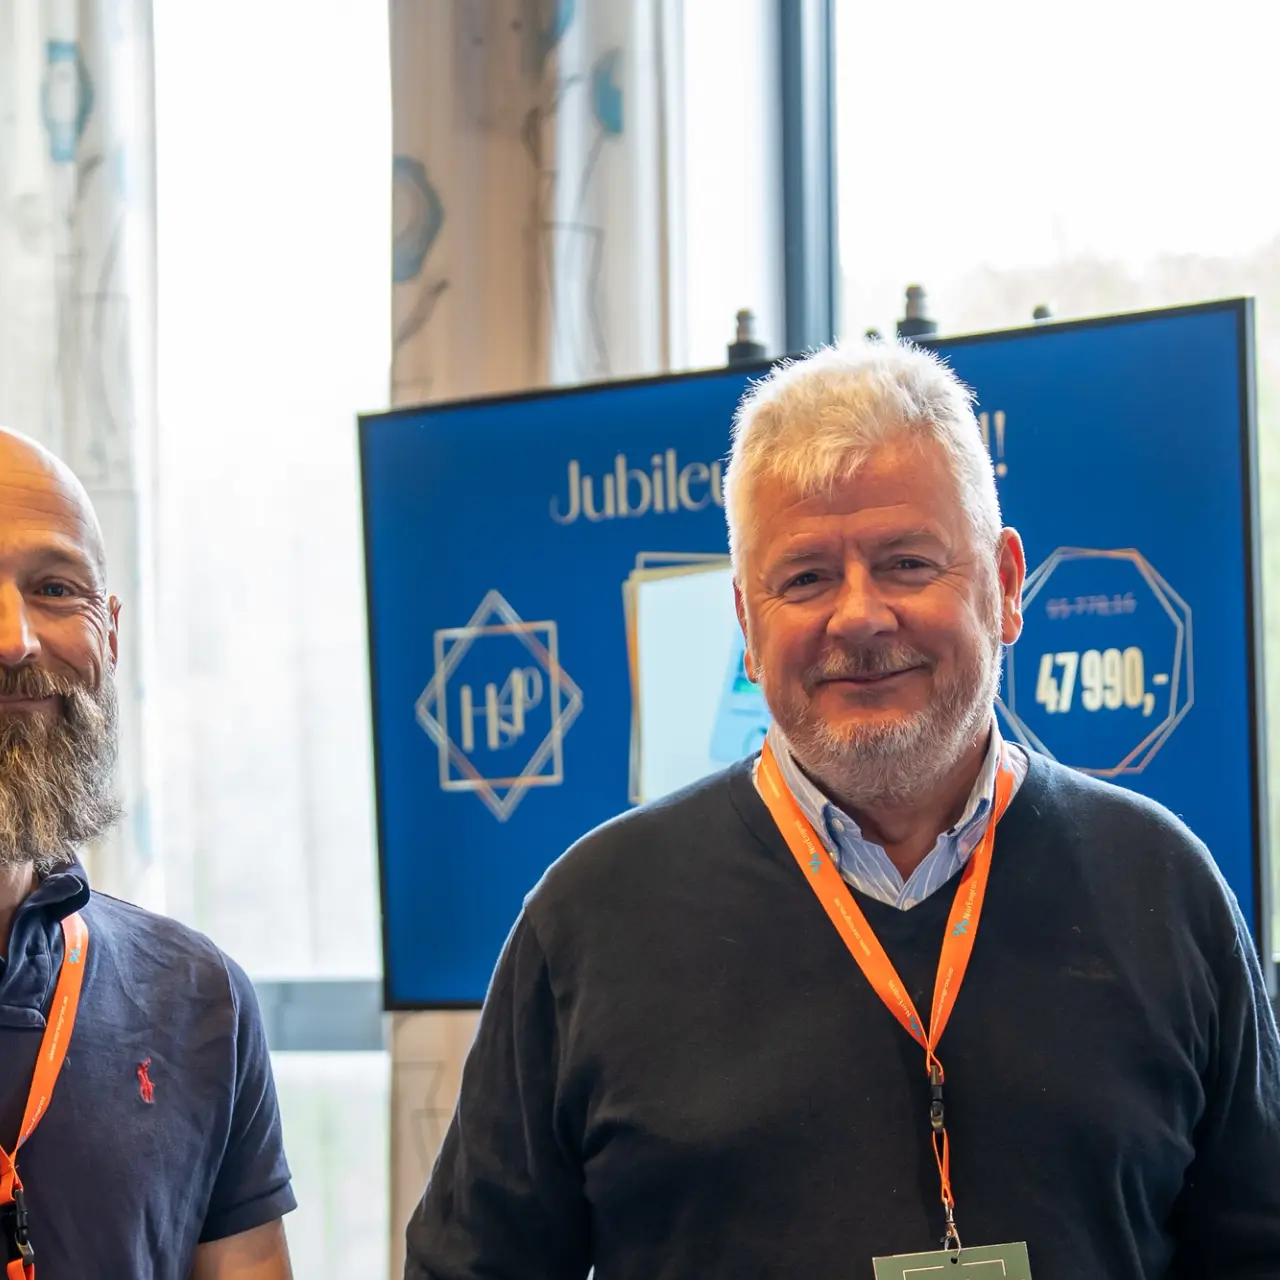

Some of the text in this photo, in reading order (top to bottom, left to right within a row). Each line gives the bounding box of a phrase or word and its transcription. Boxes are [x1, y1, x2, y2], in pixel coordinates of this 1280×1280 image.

[1035, 651, 1079, 714] 47
[795, 820, 817, 855] NorEngros
[962, 881, 978, 920] NorEngros
